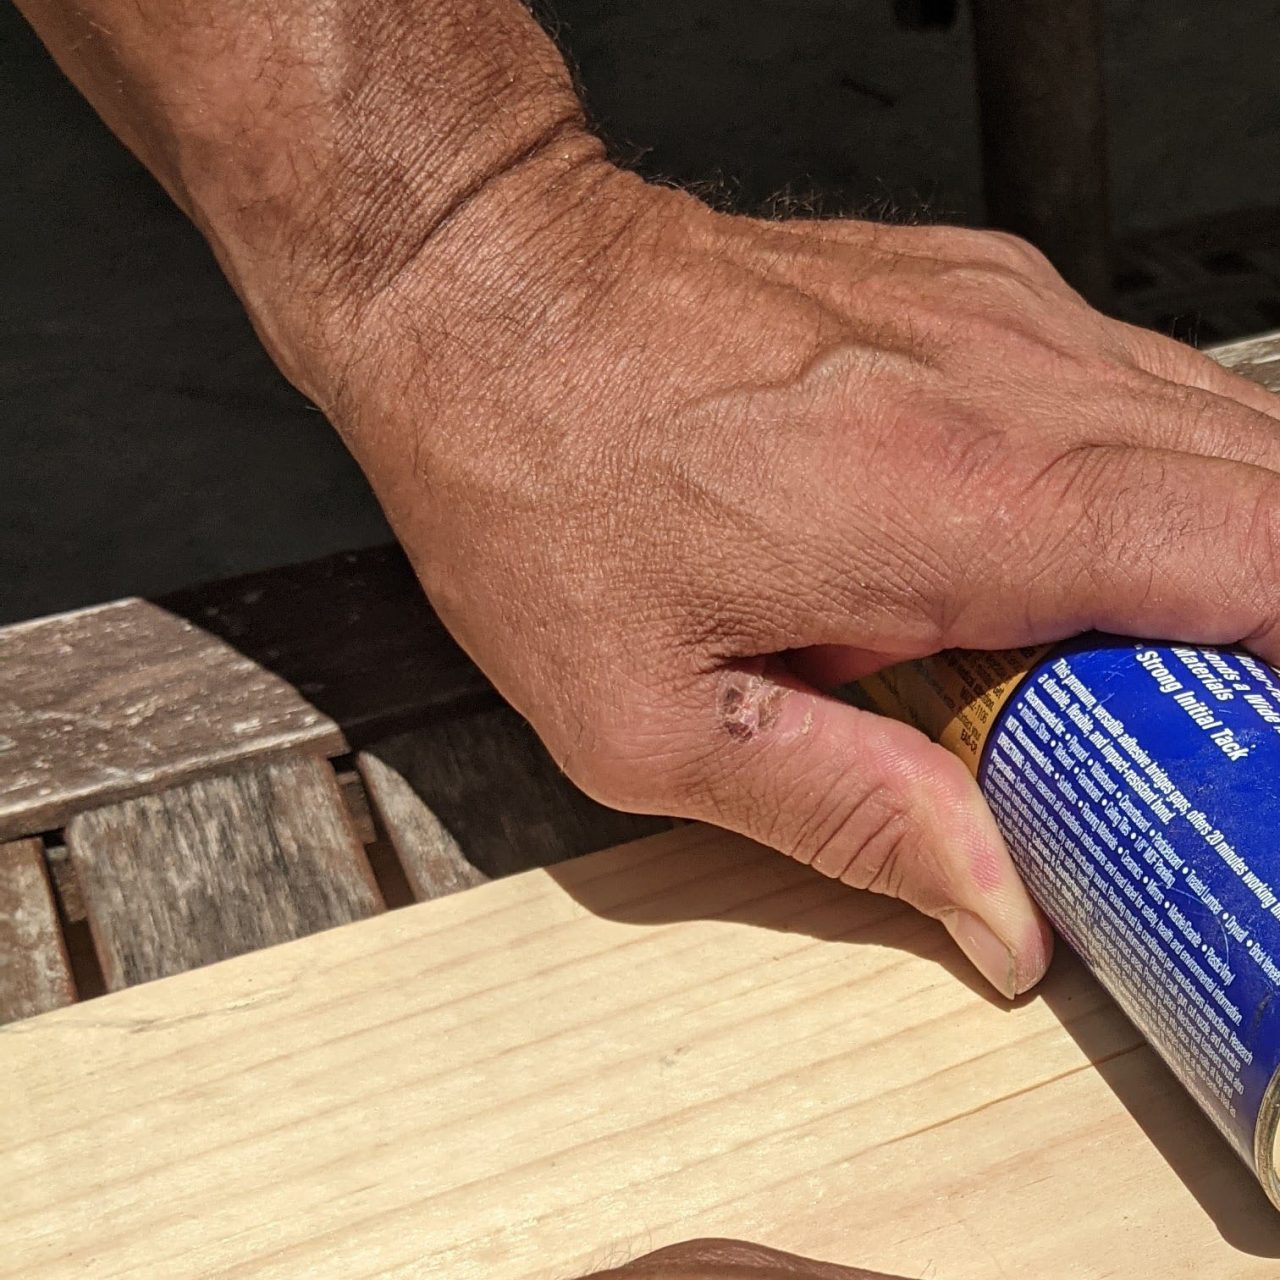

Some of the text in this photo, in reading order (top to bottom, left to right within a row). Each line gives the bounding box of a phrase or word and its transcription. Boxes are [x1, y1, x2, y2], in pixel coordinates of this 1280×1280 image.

[1136, 650, 1248, 760] Strong Initial Tack
[1172, 648, 1232, 699] Materials
[1244, 694, 1280, 722] Wide
[1037, 673, 1175, 824] a durable, flexible, and impact-resistant bond.
[1052, 658, 1070, 678] This
[1062, 674, 1096, 710] premium,
[1092, 705, 1123, 736] versatile
[1117, 733, 1150, 767] adhesive
[1145, 762, 1174, 793] bridges
[1166, 790, 1191, 815] gaps,
[1186, 810, 1212, 835] offers
[1205, 830, 1223, 845] 20
[1215, 841, 1248, 875] minutes
[1242, 871, 1276, 908] working
[1024, 687, 1059, 727] Recommended
[1053, 720, 1065, 736] for:
[1067, 735, 1089, 762] Plywood
[1090, 761, 1118, 794] Waferboard
[1118, 794, 1151, 832] Cementboard
[1152, 832, 1184, 869] Particleboard
[1185, 869, 1207, 895] Treated
[1201, 888, 1223, 914] Lumber
[1225, 915, 1248, 942] Drywall
[1248, 942, 1266, 964] Brick
